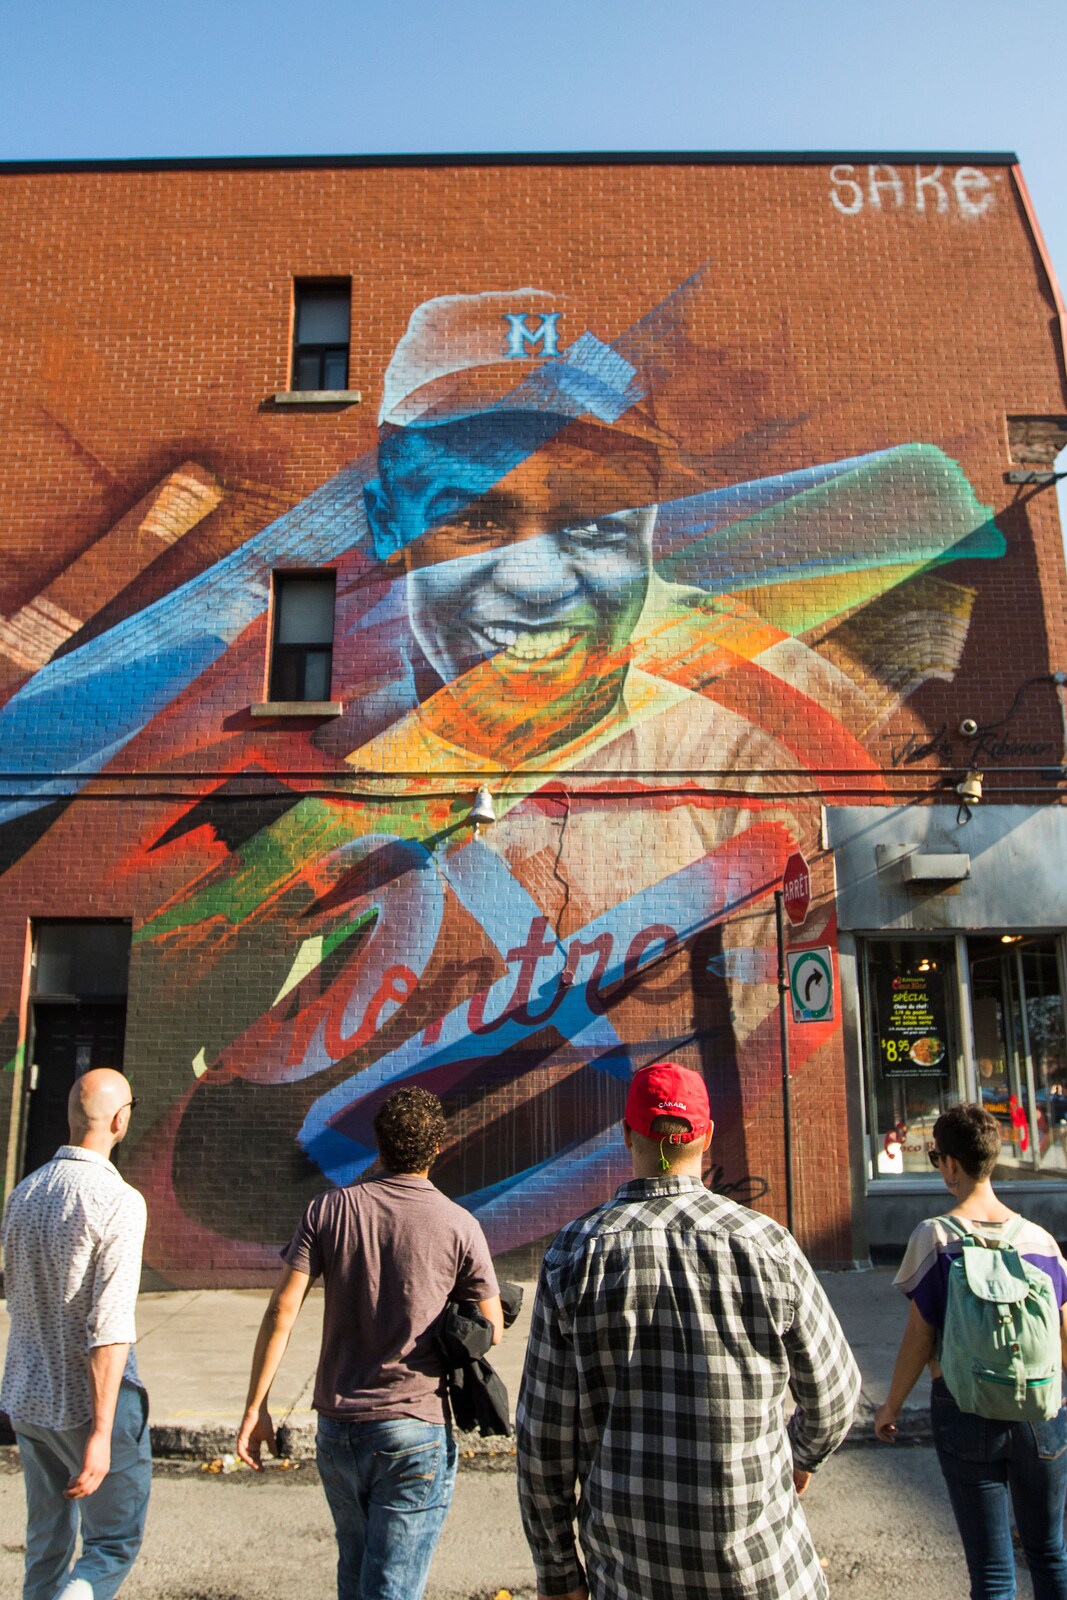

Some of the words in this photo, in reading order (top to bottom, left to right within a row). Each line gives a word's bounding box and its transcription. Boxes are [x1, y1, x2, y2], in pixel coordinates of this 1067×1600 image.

[503, 312, 564, 358] M
[785, 872, 809, 901] ARRÊT
[893, 991, 929, 1002] SPÉCIAL
[658, 1101, 687, 1111] CANADA
